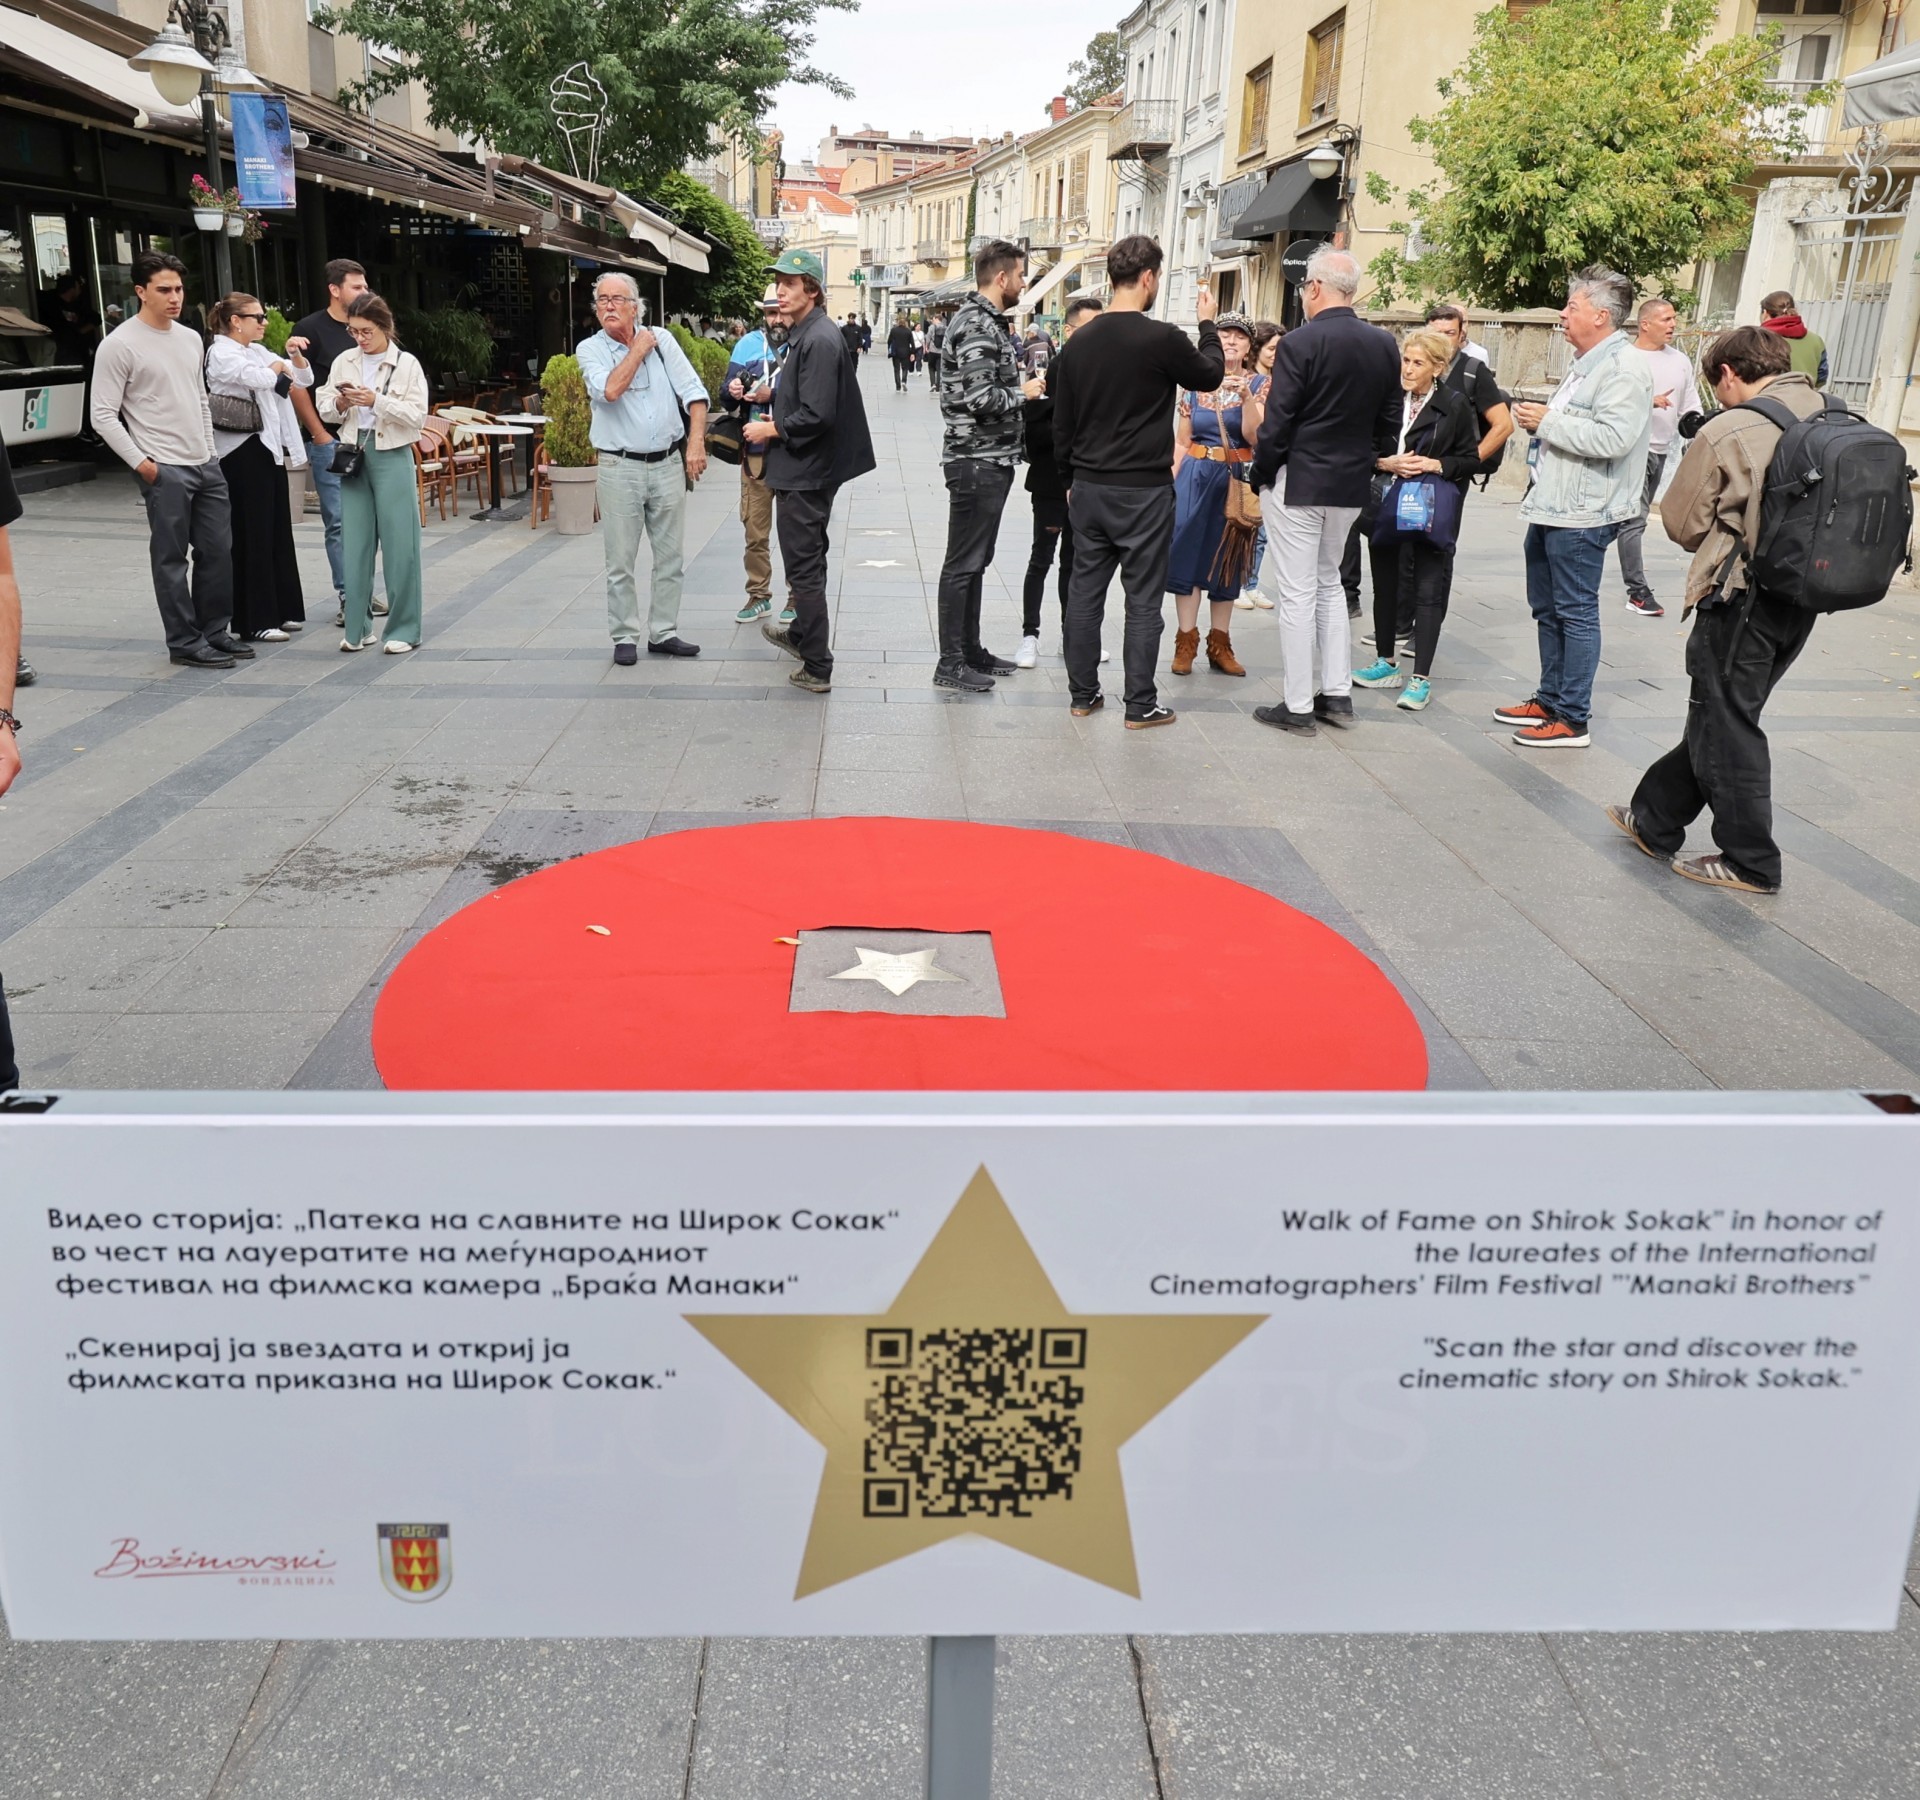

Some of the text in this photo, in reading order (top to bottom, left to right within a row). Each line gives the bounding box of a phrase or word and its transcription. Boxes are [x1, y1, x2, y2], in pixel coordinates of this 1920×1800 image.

[1402, 493, 1415, 502] 46
[47, 1207, 143, 1232] Видео
[151, 1207, 283, 1236] сторија:
[430, 1213, 468, 1231] на
[477, 1213, 623, 1231] славните
[631, 1213, 669, 1231] на
[679, 1208, 782, 1236] Широк
[1281, 1209, 1351, 1232] Walk
[1360, 1208, 1389, 1232] of
[1396, 1209, 1477, 1232] Fame
[1485, 1214, 1522, 1232] on
[1530, 1209, 1616, 1232] Shirok
[1730, 1209, 1756, 1231] in
[1764, 1209, 1848, 1232] honor
[1854, 1209, 1884, 1232] of
[51, 1238, 709, 1269] во чест на лауератите на меѓународниот
[1415, 1241, 1877, 1264] the laureates of the International
[55, 1272, 214, 1300] фестивал
[221, 1278, 260, 1295] на
[268, 1273, 413, 1300] филмска
[422, 1278, 541, 1301] камера
[1149, 1273, 1425, 1301] Cinematographers'
[1433, 1273, 1489, 1295] Film
[1497, 1273, 1603, 1296] Festival
[228, 1336, 257, 1364] ја
[411, 1342, 429, 1359] и
[437, 1337, 535, 1364] откриј
[541, 1337, 570, 1364] ја
[1423, 1336, 1858, 1359] "Scan the star and discover the
[67, 1367, 246, 1394] филмската
[255, 1373, 397, 1395] приказна
[406, 1373, 443, 1390] на
[452, 1369, 553, 1395] Широк
[1398, 1367, 1539, 1389] cinematic
[1548, 1368, 1615, 1393] story
[1622, 1372, 1658, 1389] on
[1665, 1367, 1749, 1389] Shirok
